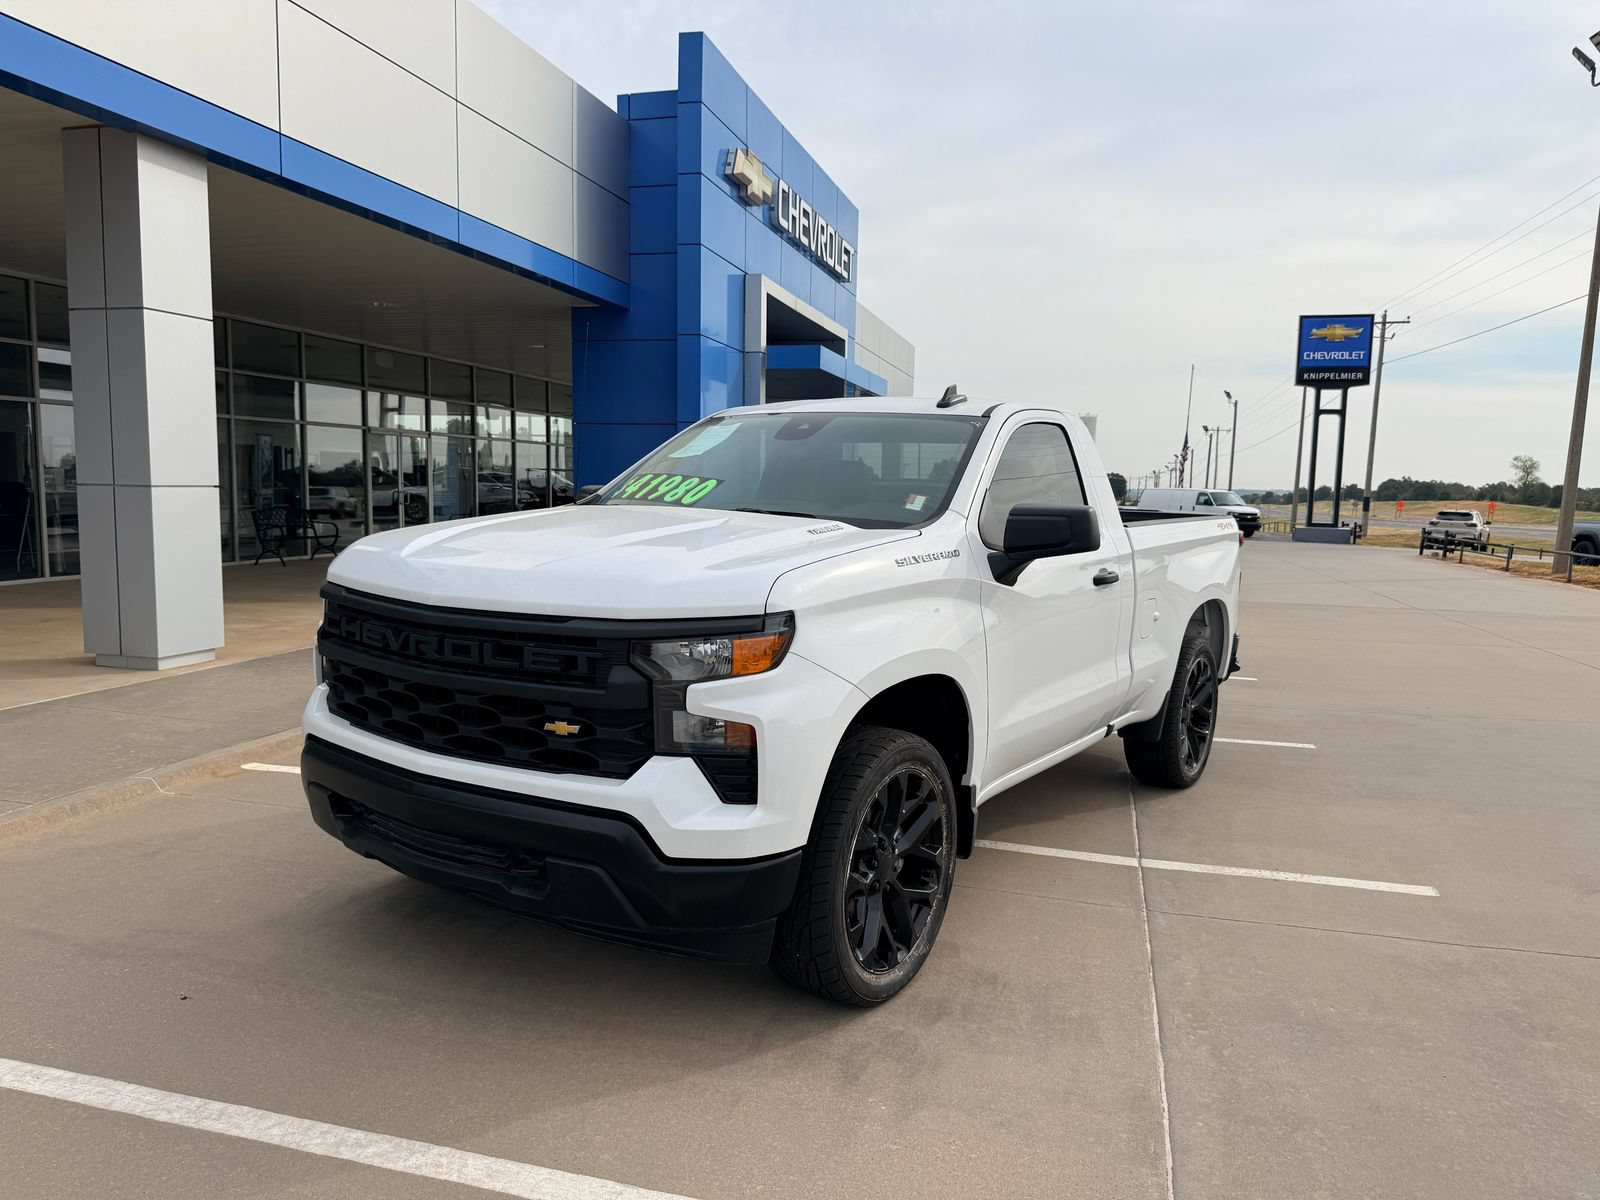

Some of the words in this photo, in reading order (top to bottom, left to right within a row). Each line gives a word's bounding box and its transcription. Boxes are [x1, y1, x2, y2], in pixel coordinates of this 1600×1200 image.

[777, 178, 855, 281] CHEVROLET
[1303, 350, 1365, 360] CHEVROLET
[1303, 372, 1363, 380] KNIPPELMIER
[324, 612, 605, 675] CHEVROLET
